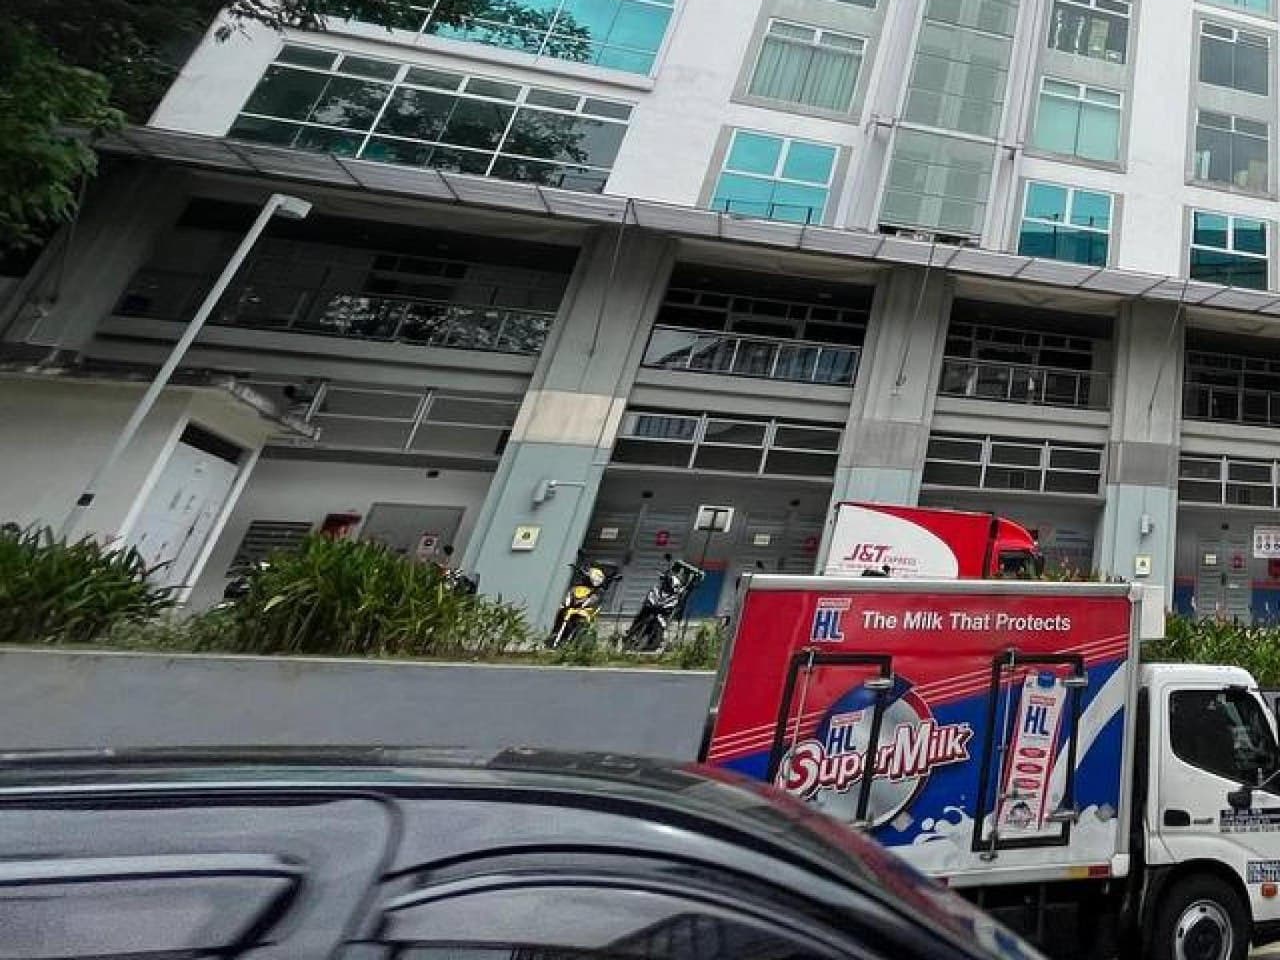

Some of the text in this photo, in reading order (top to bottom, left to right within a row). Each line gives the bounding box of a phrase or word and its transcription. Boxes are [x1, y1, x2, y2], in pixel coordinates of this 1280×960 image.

[844, 543, 891, 563] J&T
[811, 608, 846, 641] HL
[862, 611, 1072, 631] The Milk That Protects
[1023, 705, 1050, 735] HL
[826, 725, 857, 755] HL
